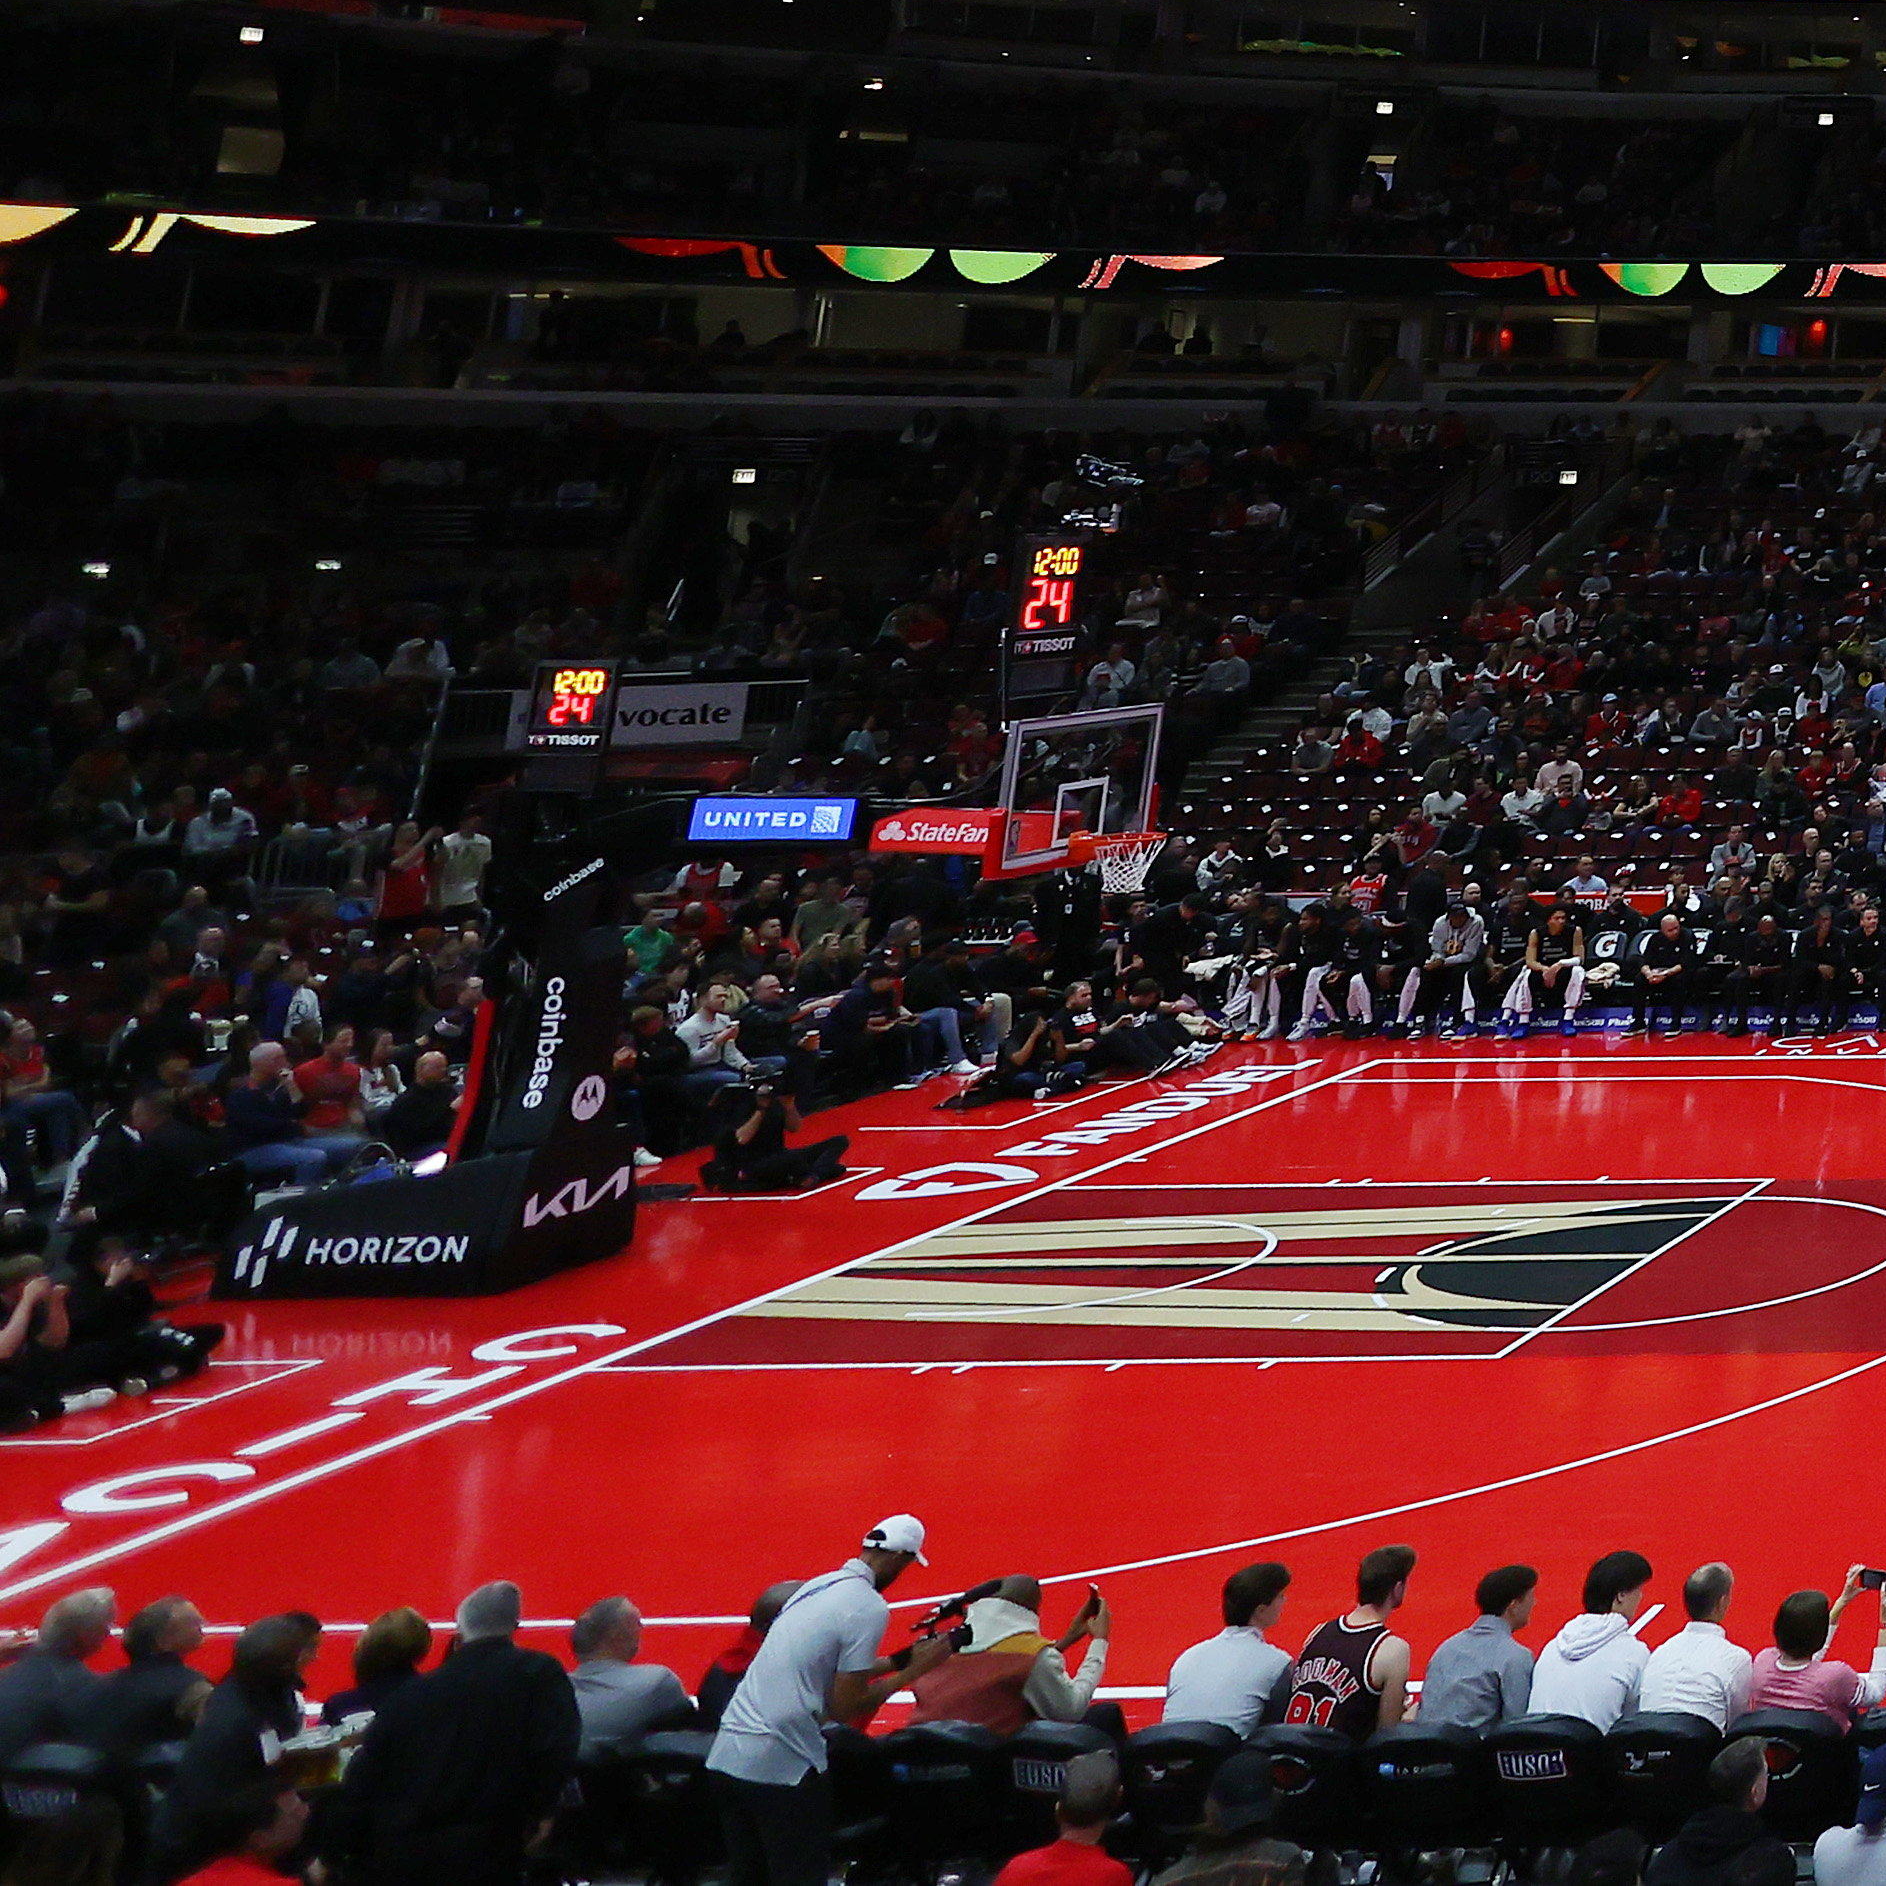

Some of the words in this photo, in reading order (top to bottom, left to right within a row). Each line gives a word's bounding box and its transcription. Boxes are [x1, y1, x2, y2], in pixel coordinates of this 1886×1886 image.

[733, 469, 755, 483] EXIT
[1034, 546, 1082, 576] 12:00
[1023, 579, 1074, 630] 24
[1033, 636, 1077, 655] TISSOT
[554, 668, 605, 696] 12:00
[548, 696, 594, 726] 24
[618, 702, 732, 729] vocate
[543, 733, 600, 748] TISSOT
[703, 808, 807, 829] UNITED
[543, 857, 605, 902] coinbase
[1594, 934, 1618, 958] G
[522, 976, 566, 1110] coinbase
[993, 1058, 1323, 1158] FANDUEL
[304, 1233, 470, 1266] HORIZON
[1284, 1691, 1337, 1729] 91
